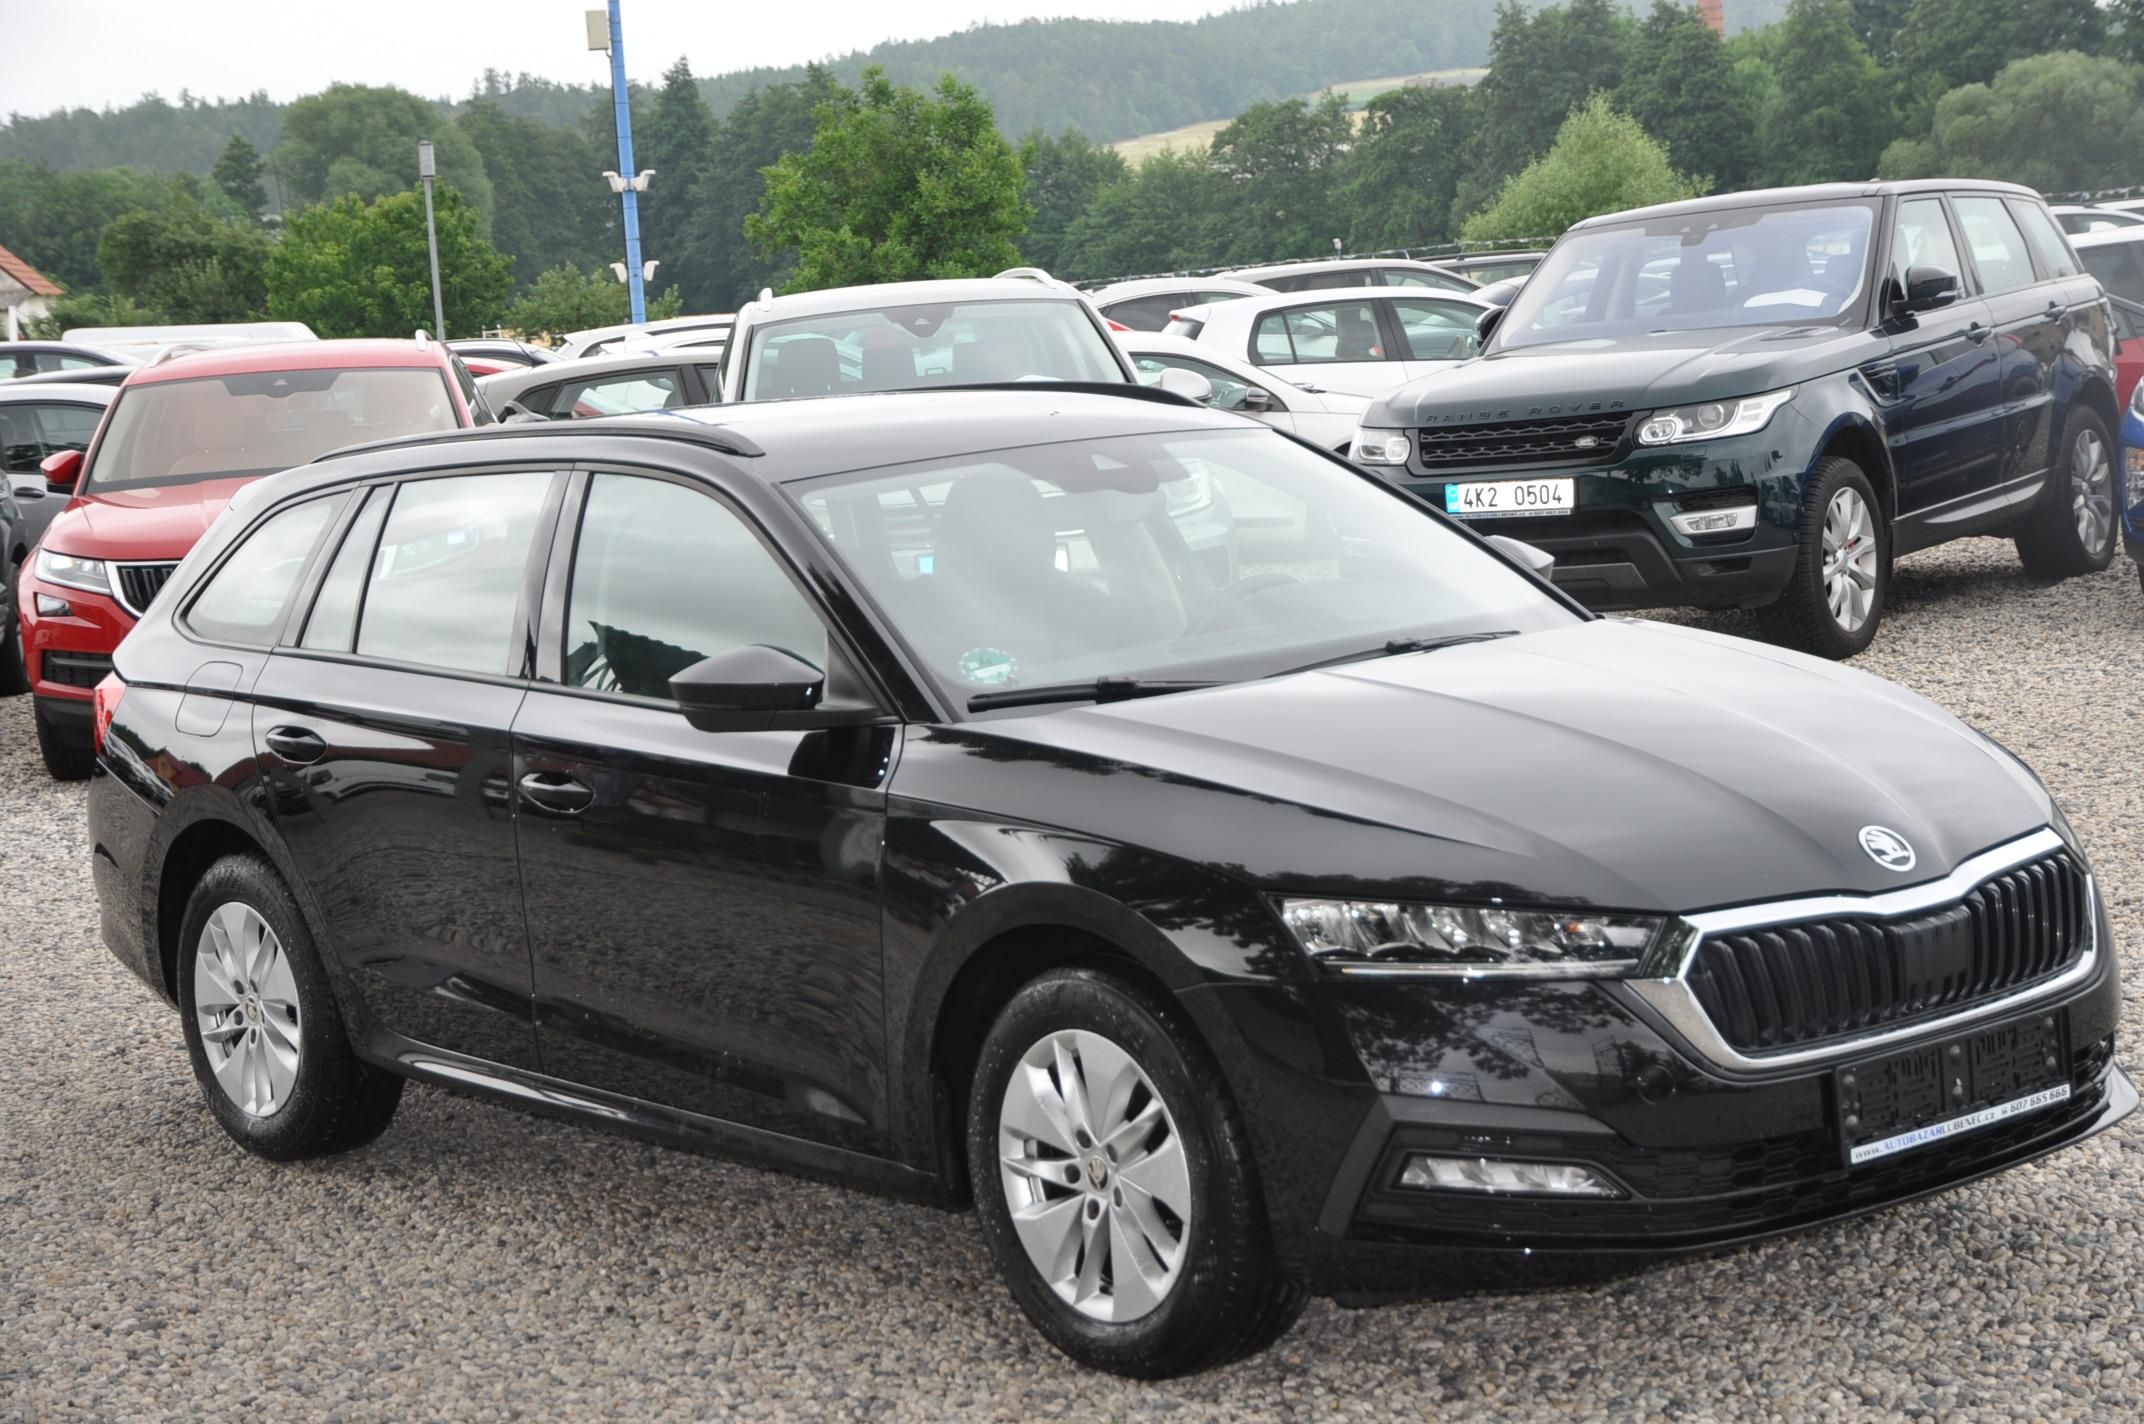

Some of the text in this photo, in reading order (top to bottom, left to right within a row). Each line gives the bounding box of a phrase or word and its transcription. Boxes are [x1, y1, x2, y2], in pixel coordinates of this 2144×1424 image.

[1425, 399, 1625, 424] RANGE ROVER
[1463, 483, 1562, 508] 4K2 0504
[2010, 1099, 2028, 1113] 607
